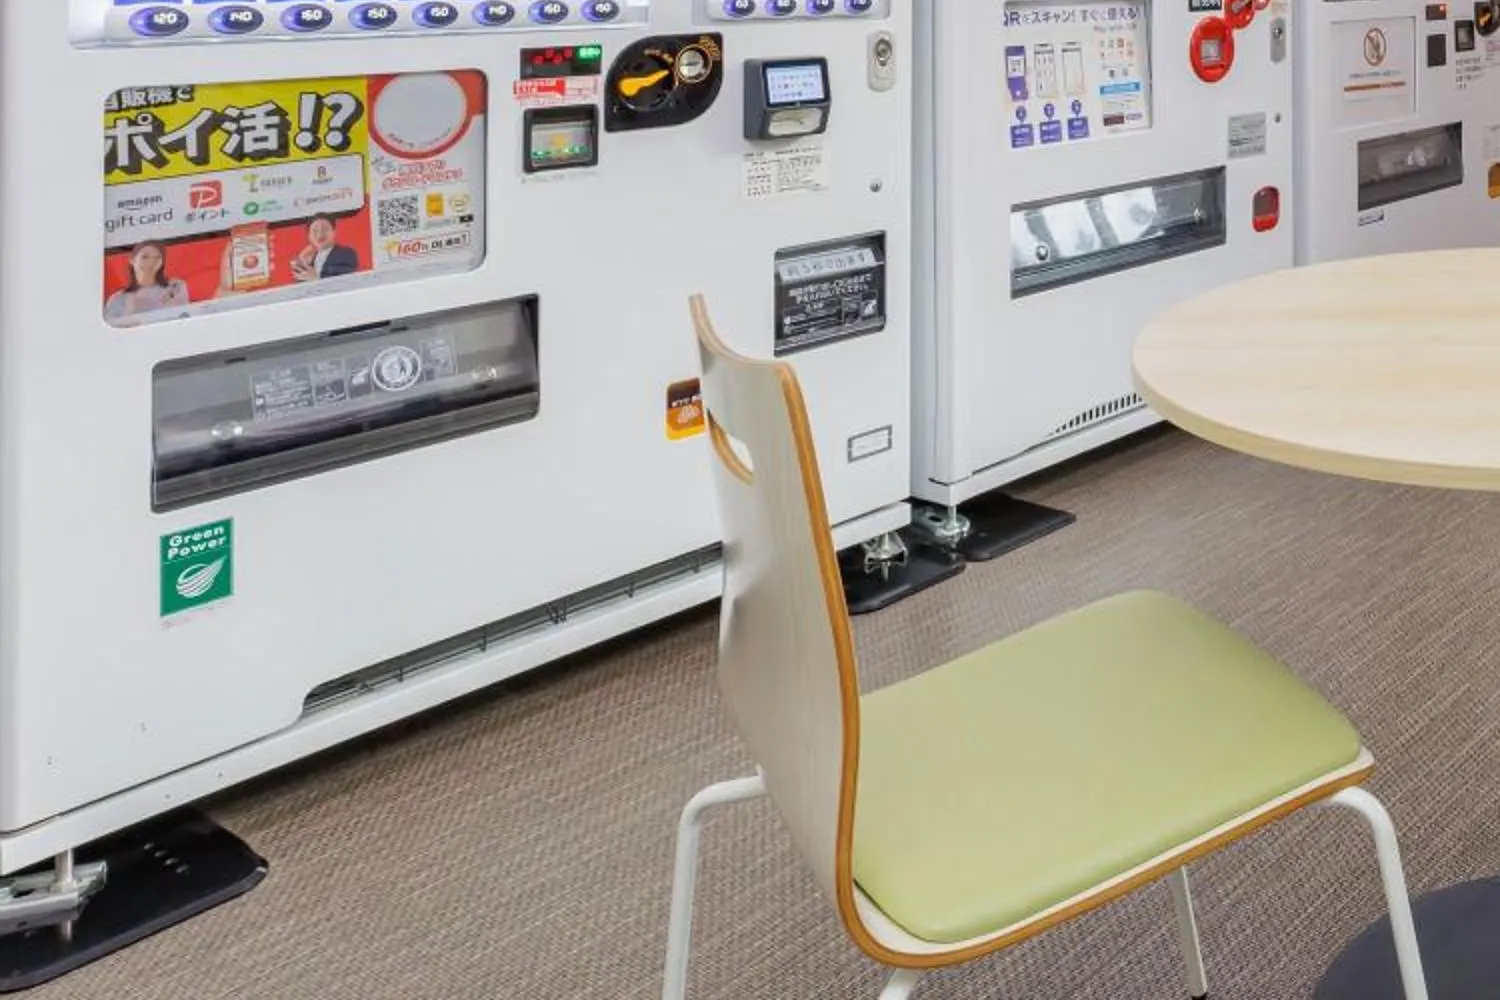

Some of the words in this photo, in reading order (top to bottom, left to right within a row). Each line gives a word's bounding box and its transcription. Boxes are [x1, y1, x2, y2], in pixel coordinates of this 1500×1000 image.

[117, 194, 163, 209] amazon
[105, 215, 134, 232] gift
[138, 210, 173, 224] card
[169, 526, 225, 547] Green
[167, 536, 227, 560] Power
